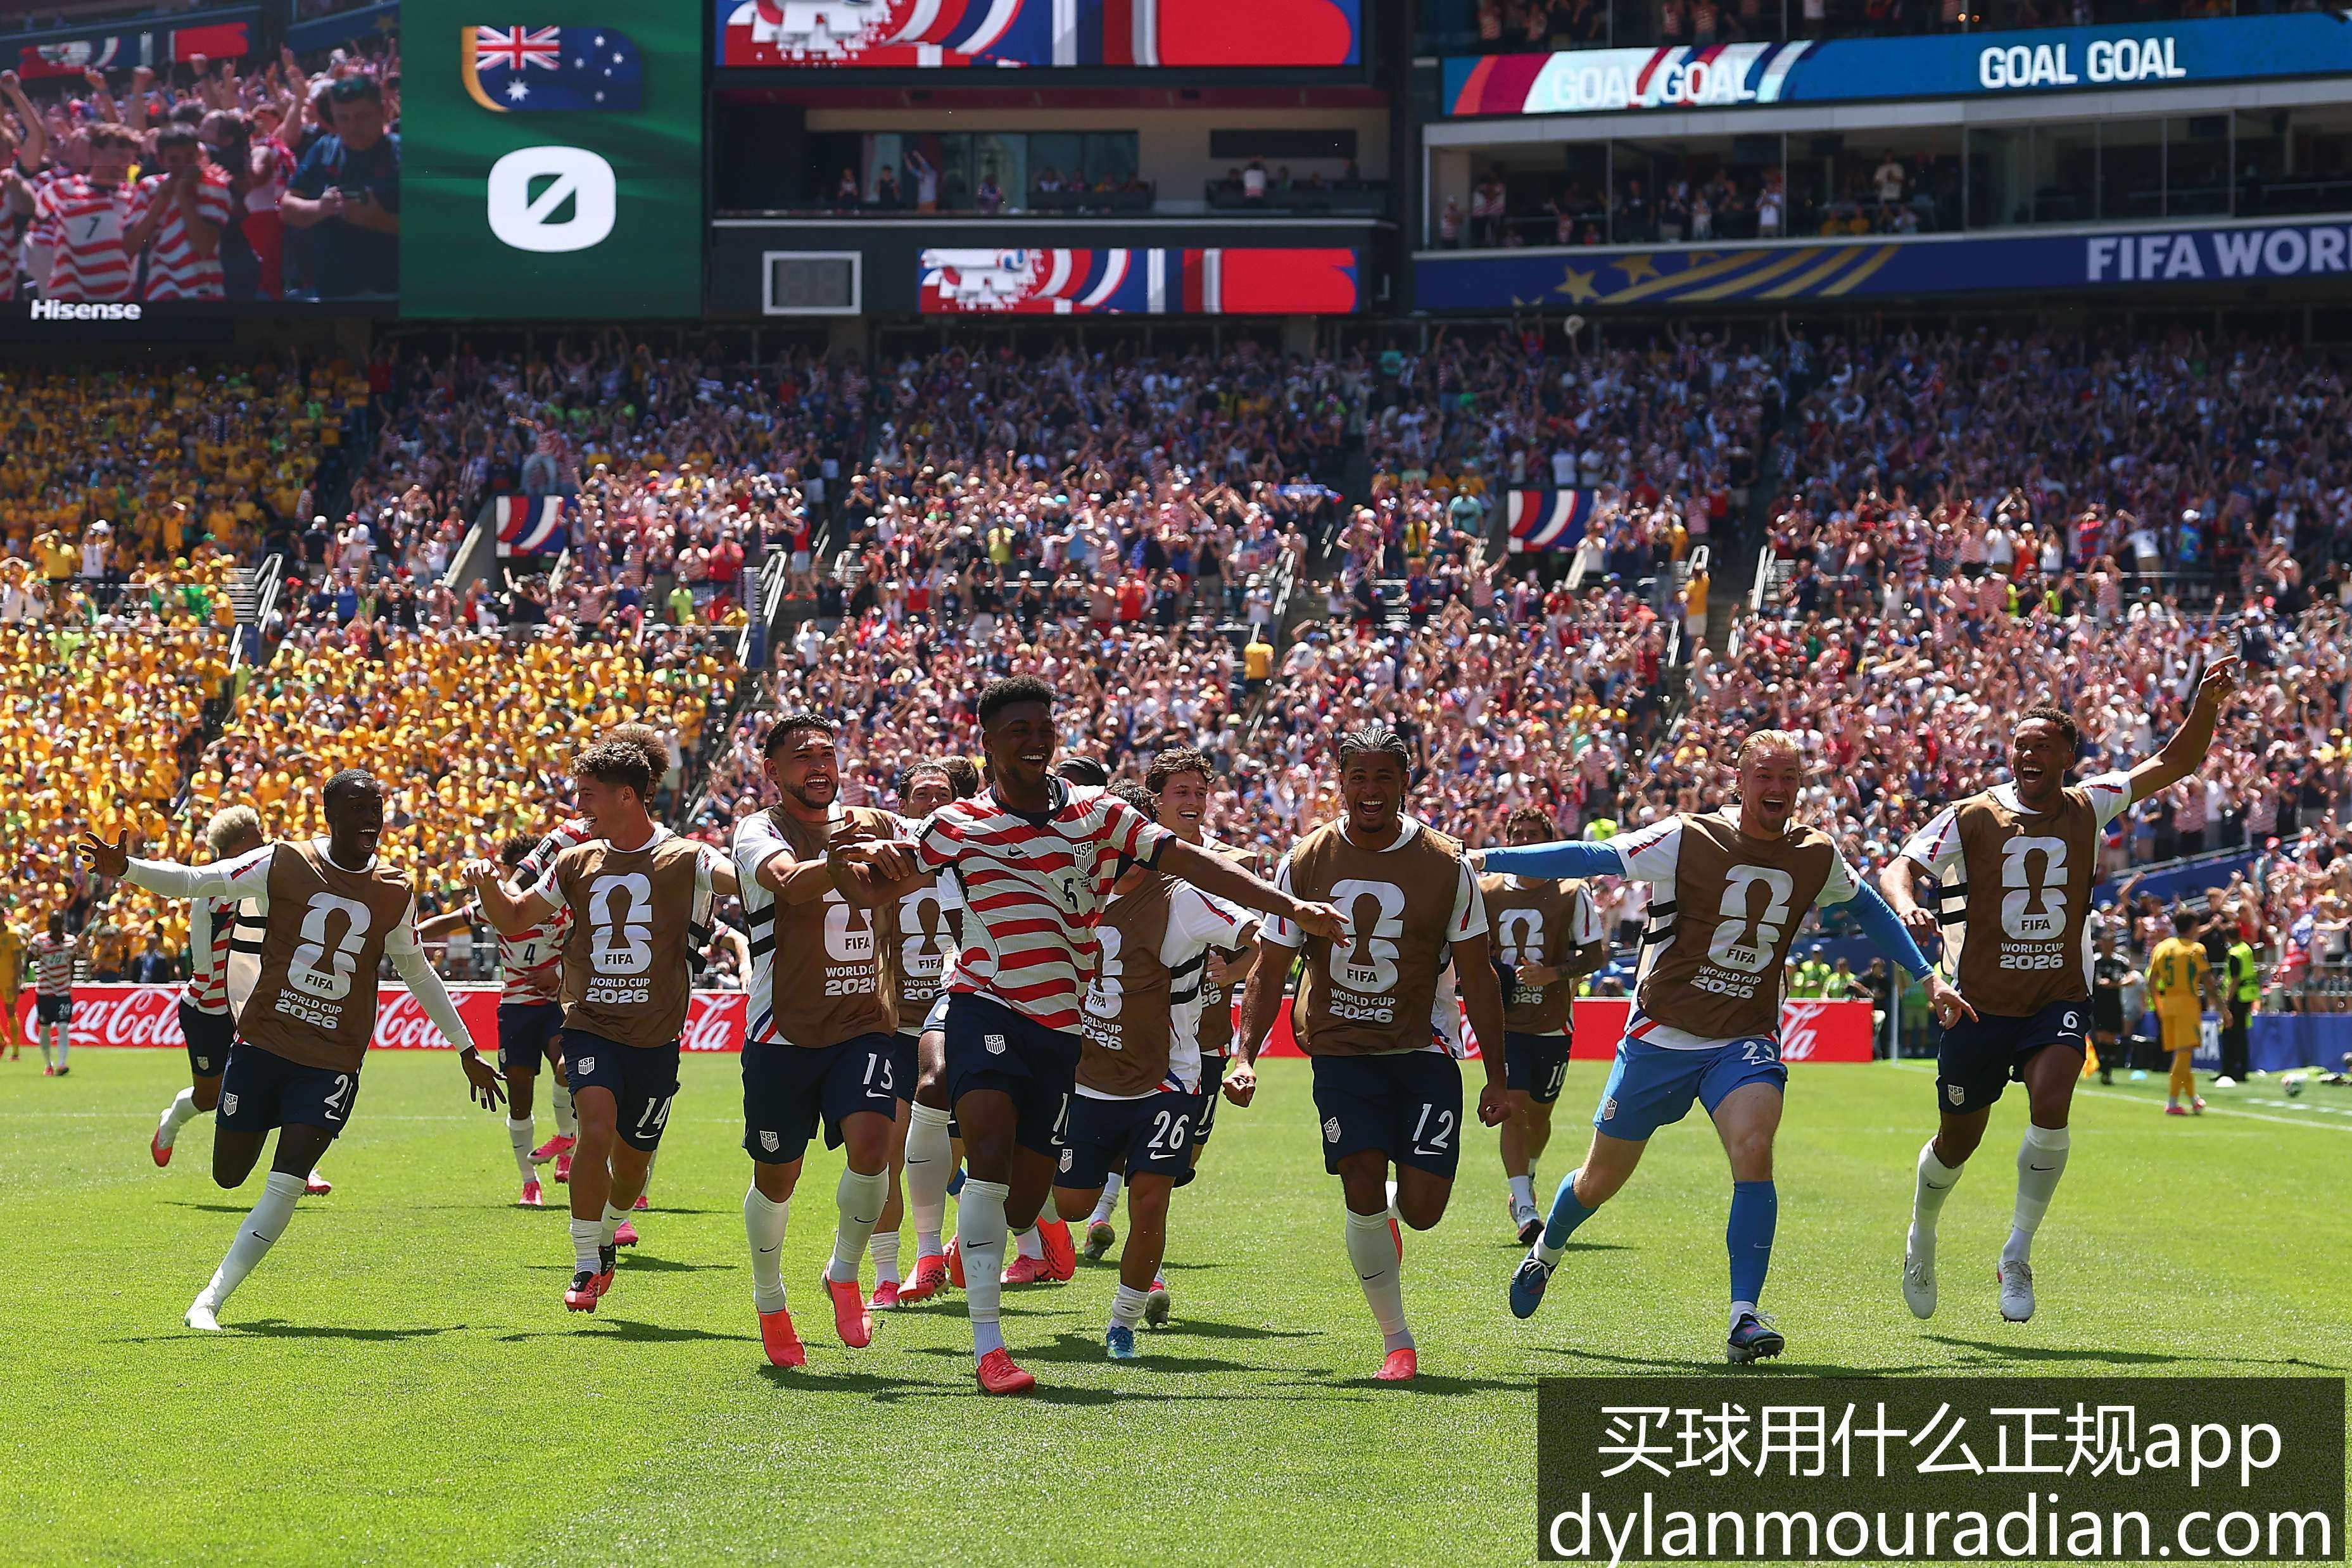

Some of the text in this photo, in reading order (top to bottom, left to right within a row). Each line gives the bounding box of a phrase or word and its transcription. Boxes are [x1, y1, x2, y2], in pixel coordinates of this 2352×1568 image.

[1979, 36, 2186, 89] GOAL GOAL
[1552, 61, 1756, 106] GOAL GOAL
[2087, 225, 2352, 282] FIFA WOR
[30, 298, 142, 320] Hisense
[1074, 842, 1092, 856] USA
[2021, 918, 2051, 931] FIFA
[845, 937, 871, 951] FIFA
[2001, 942, 2064, 953] WORLD CUP
[523, 943, 536, 965] 4
[604, 953, 634, 964] FIFA
[1726, 947, 1756, 964] FIFA
[1999, 954, 2064, 970] 2026
[825, 965, 868, 978] WORLD
[1346, 968, 1378, 983] FIFA
[1698, 965, 1741, 982] WORLD
[305, 972, 334, 991] FIFA
[589, 977, 650, 988] WORLD CUP
[902, 979, 940, 987] WORLD
[1203, 982, 1218, 993] CU
[1690, 975, 1754, 999] 2026
[279, 988, 343, 1015] WORLD CUP
[585, 989, 649, 1004] 2026
[904, 988, 935, 1001] 20
[1090, 992, 1106, 1009] FIFA
[1202, 989, 1222, 1009] 26
[1331, 988, 1396, 1008] WORLD CUP
[1511, 992, 1543, 1005] 026
[274, 999, 338, 1030] 2026
[1329, 999, 1394, 1024] 2026
[1083, 1015, 1122, 1035] ORLD CUP
[2063, 1011, 2079, 1030] 6
[985, 1034, 1004, 1044] USA
[1082, 1025, 1123, 1051] 026
[579, 1057, 595, 1066] USA
[863, 1053, 893, 1091] 15
[1546, 1061, 1567, 1091] 10
[225, 1094, 237, 1104] USA
[324, 1075, 354, 1114] 21
[1949, 1086, 1964, 1096] USA
[636, 1097, 672, 1130] 14
[1052, 1092, 1070, 1137] 1
[1147, 1110, 1189, 1150] 26
[1325, 1118, 1337, 1132] USA
[1412, 1104, 1455, 1148] 12
[761, 1131, 777, 1140] USA
